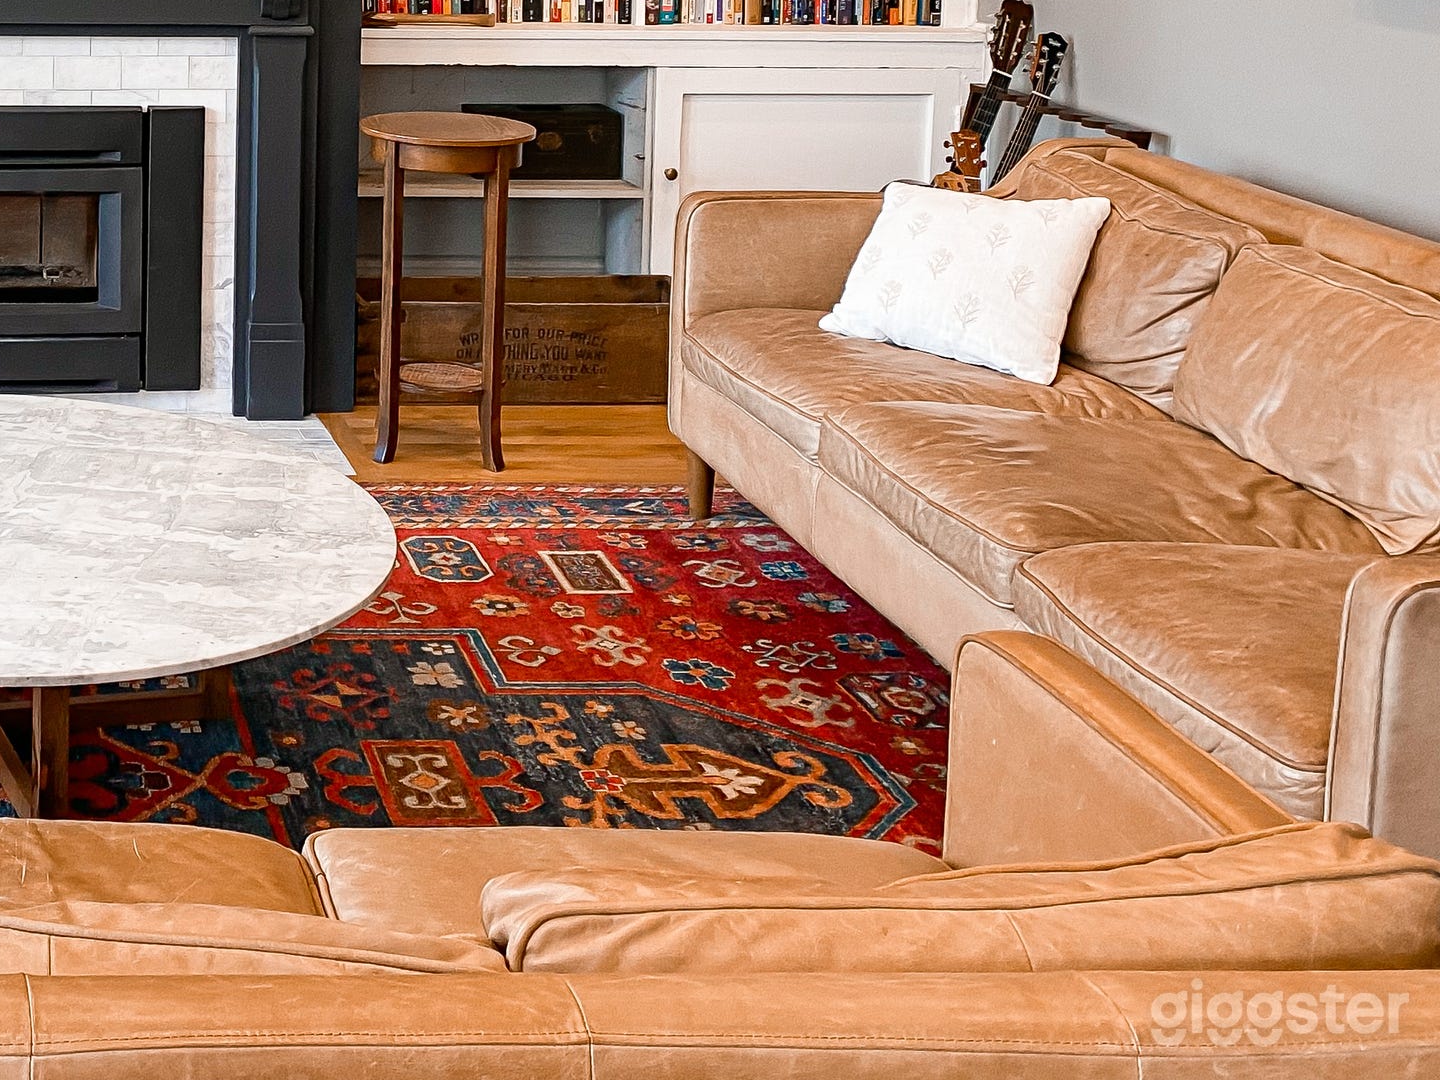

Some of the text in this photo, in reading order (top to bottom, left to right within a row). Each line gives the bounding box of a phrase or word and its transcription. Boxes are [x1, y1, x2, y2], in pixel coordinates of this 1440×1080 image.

[504, 327, 529, 340] FOR
[538, 328, 564, 340] OUR
[544, 344, 568, 361] YOU
[574, 349, 609, 361] WANT
